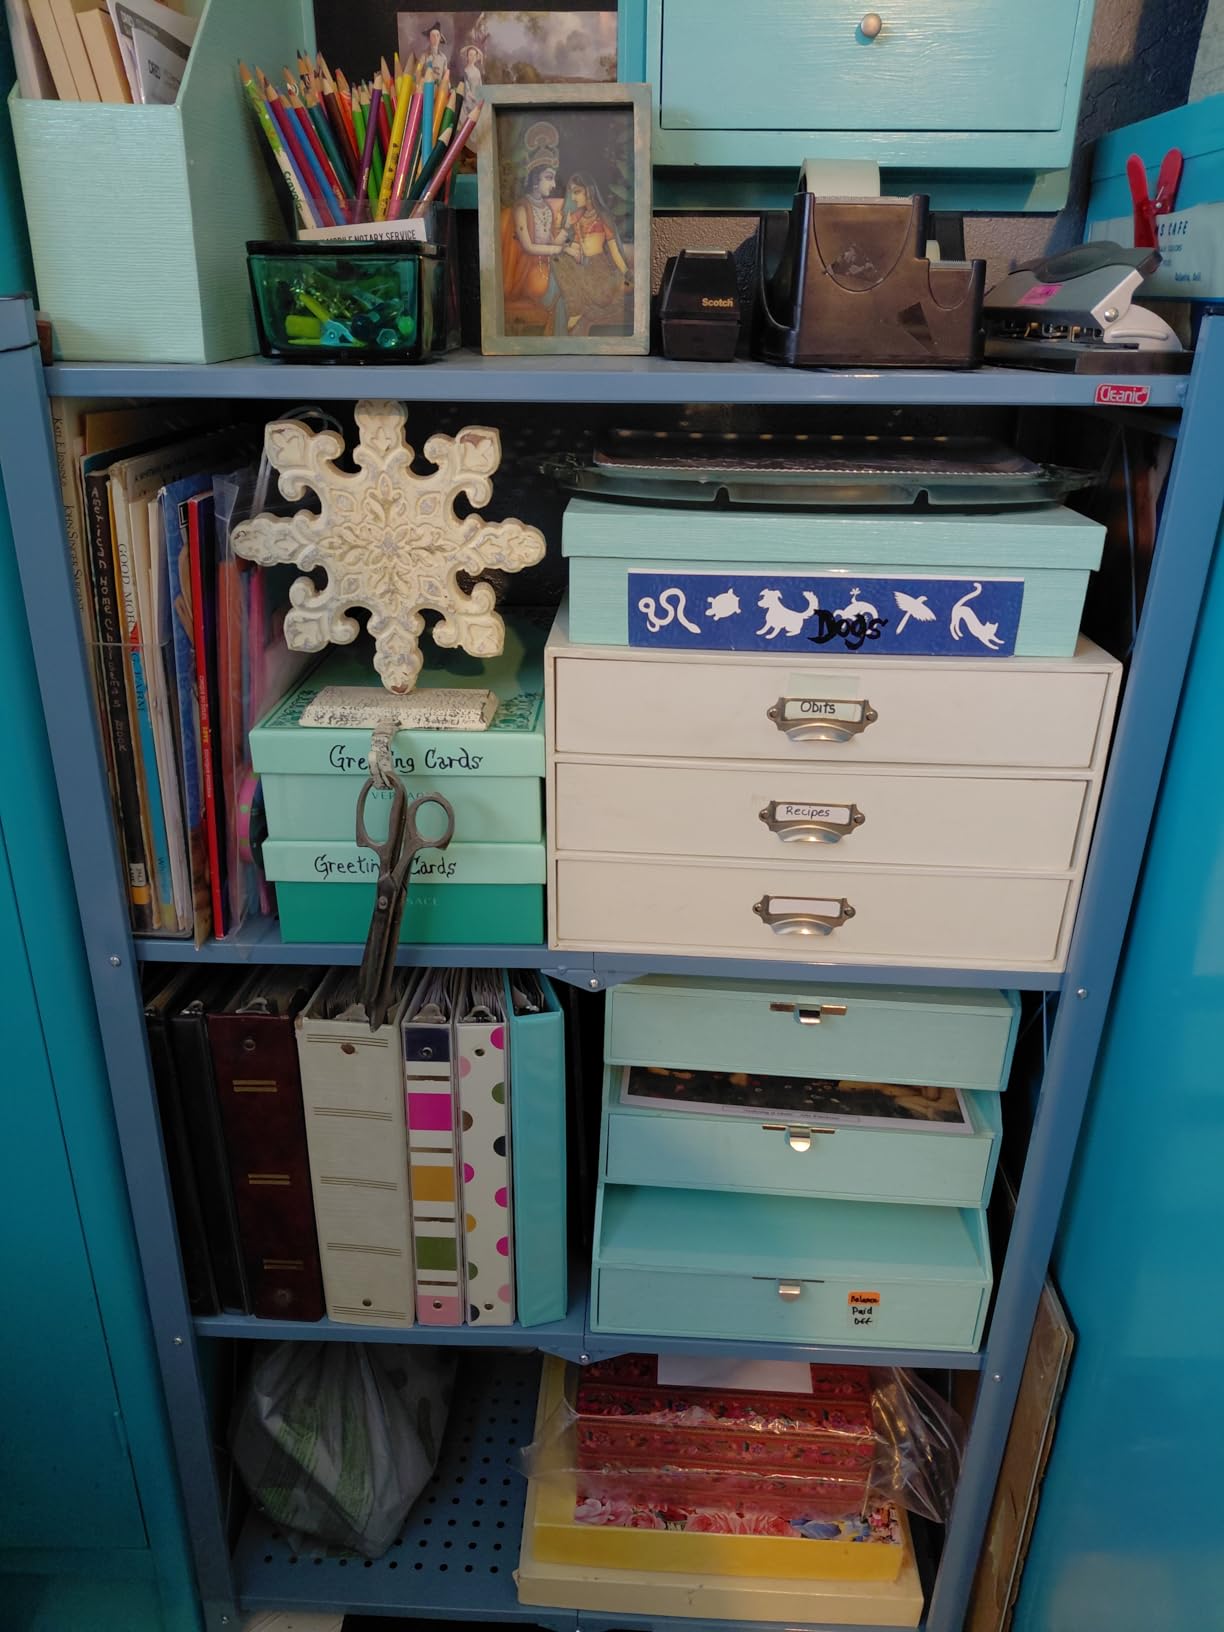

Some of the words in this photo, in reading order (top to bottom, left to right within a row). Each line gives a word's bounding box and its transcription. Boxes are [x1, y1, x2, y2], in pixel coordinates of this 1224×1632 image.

[284, 170, 303, 210] Crayola
[385, 230, 416, 241] SERVICE
[702, 297, 733, 307] Scotch
[1100, 386, 1143, 403] Cleanic
[119, 543, 130, 585] GOOD
[134, 671, 145, 711] FARM
[807, 609, 889, 650] Dogs
[800, 700, 836, 714] Obits
[329, 744, 415, 773] Greing
[424, 747, 483, 770] Cards
[785, 805, 830, 820] Recipes
[314, 854, 381, 879] Greetin
[410, 856, 457, 878] Cards
[852, 1306, 873, 1315] Paid
